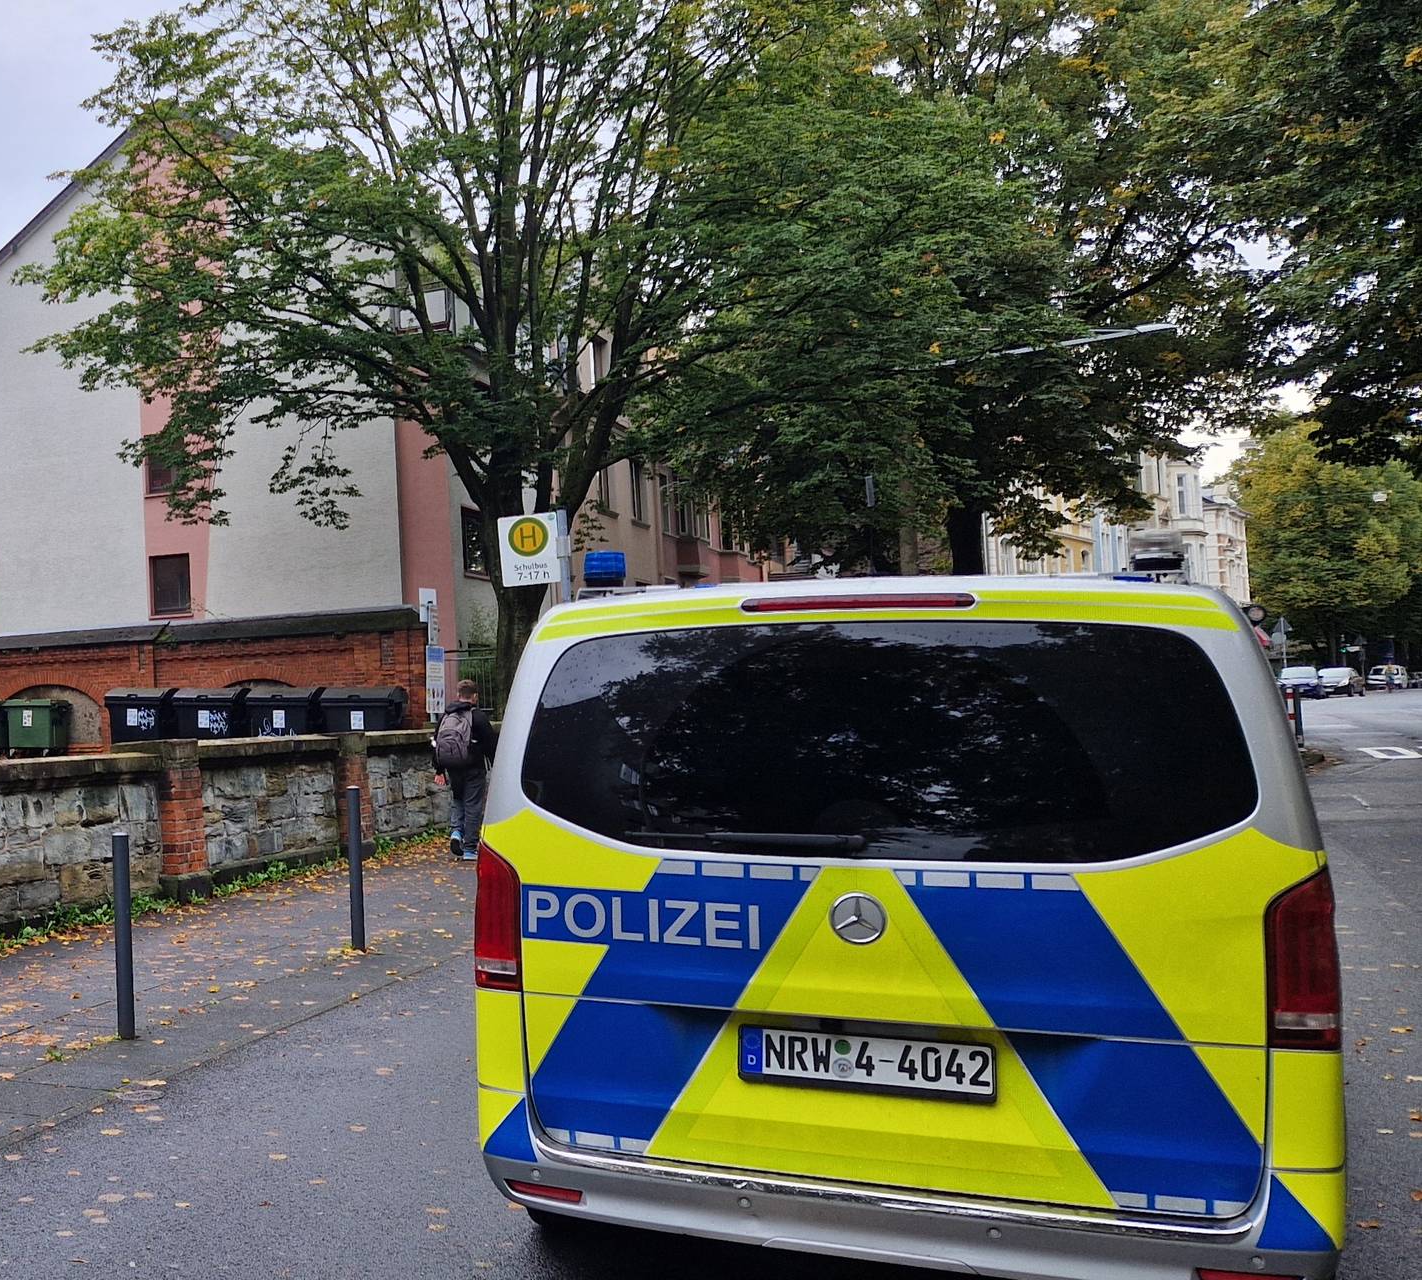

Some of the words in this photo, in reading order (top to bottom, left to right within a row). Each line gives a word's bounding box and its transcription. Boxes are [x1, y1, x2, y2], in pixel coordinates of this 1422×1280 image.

[520, 526, 536, 548] H
[514, 562, 548, 572] Schulbus
[518, 571, 540, 581] 7-17
[528, 890, 761, 950] POLIZEI
[747, 1054, 757, 1066] D
[764, 1033, 832, 1074] NRW
[854, 1040, 991, 1088] 4-4042
